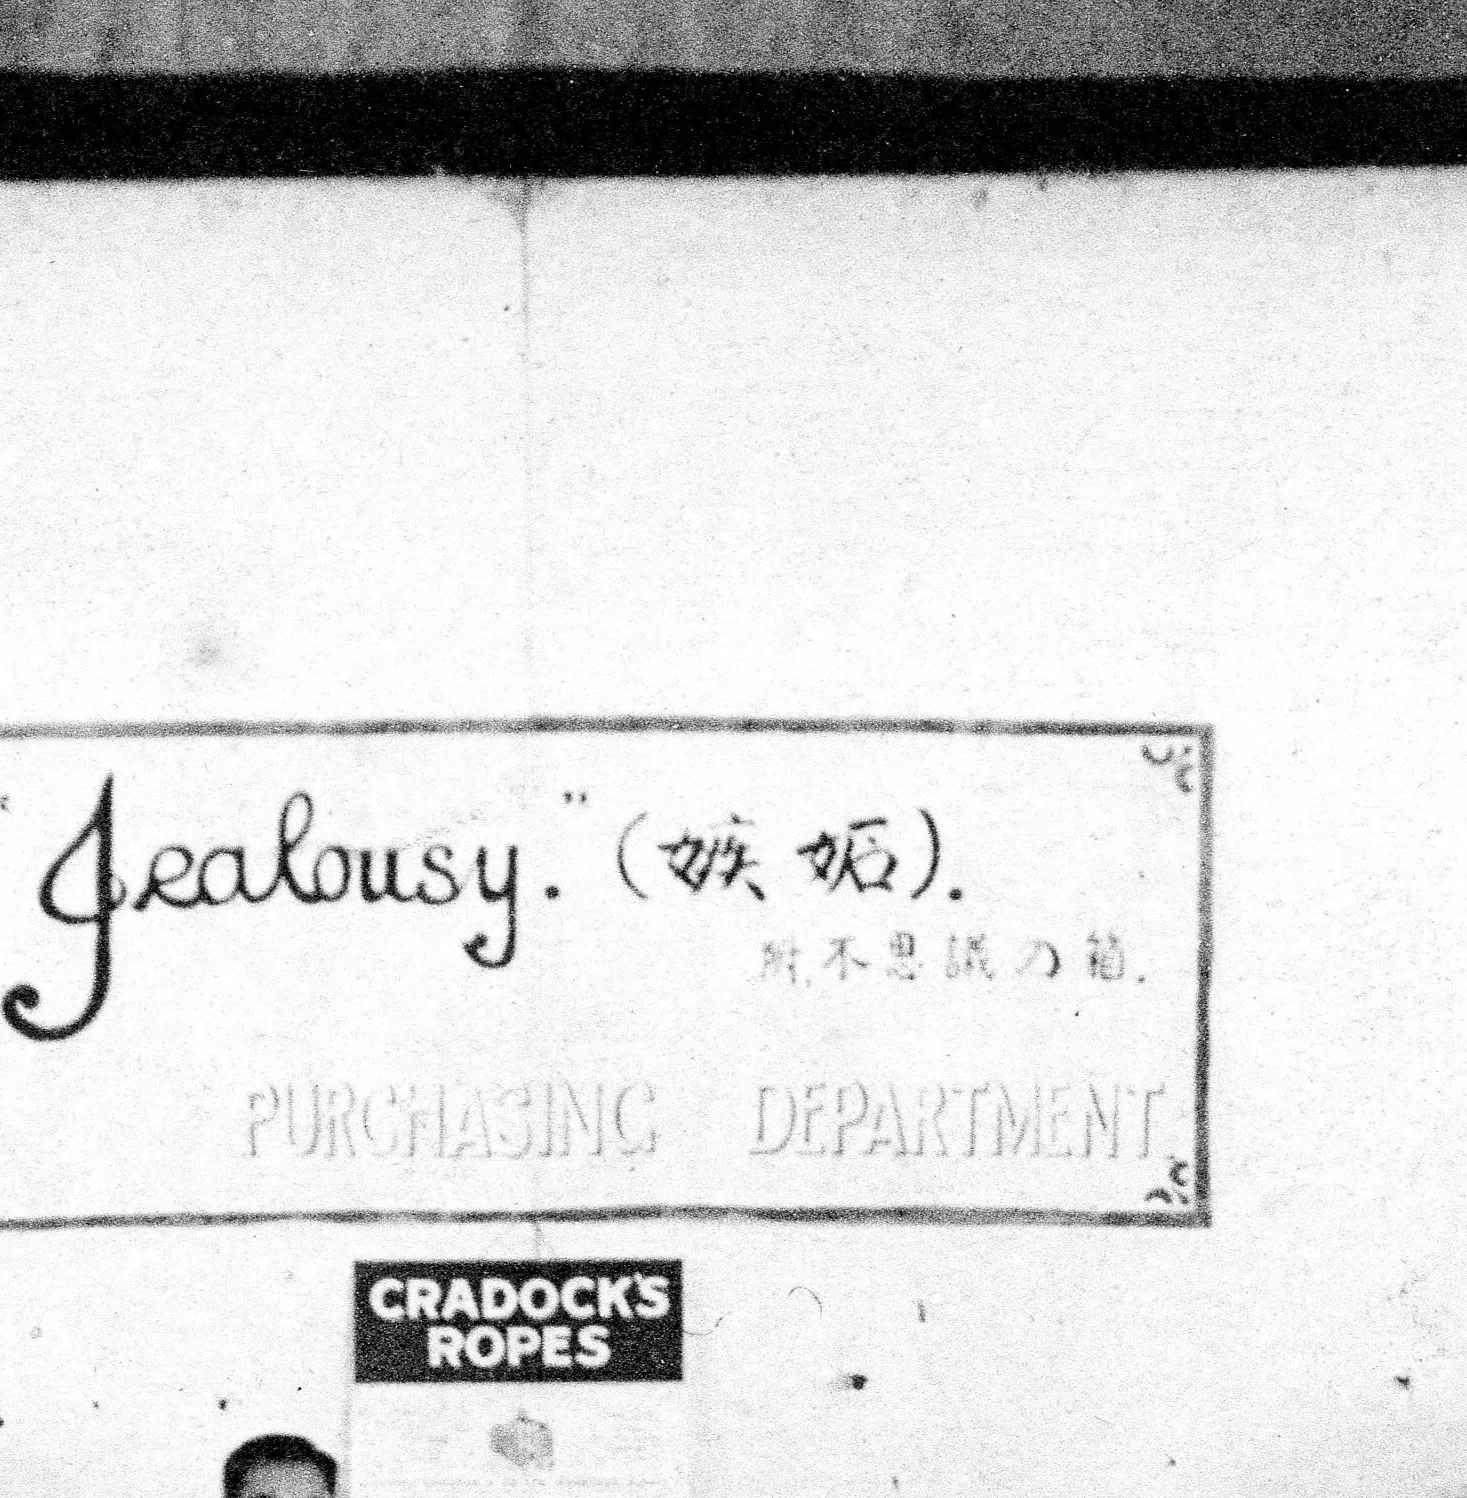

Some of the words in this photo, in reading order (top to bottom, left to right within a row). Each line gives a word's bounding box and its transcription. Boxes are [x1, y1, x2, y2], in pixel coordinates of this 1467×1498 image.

[242, 1081, 661, 1160] PURCHASING
[748, 1080, 1168, 1158] DEPARTMENT
[368, 1271, 672, 1321] CRADOCK'S
[431, 1325, 613, 1368] ROPES
